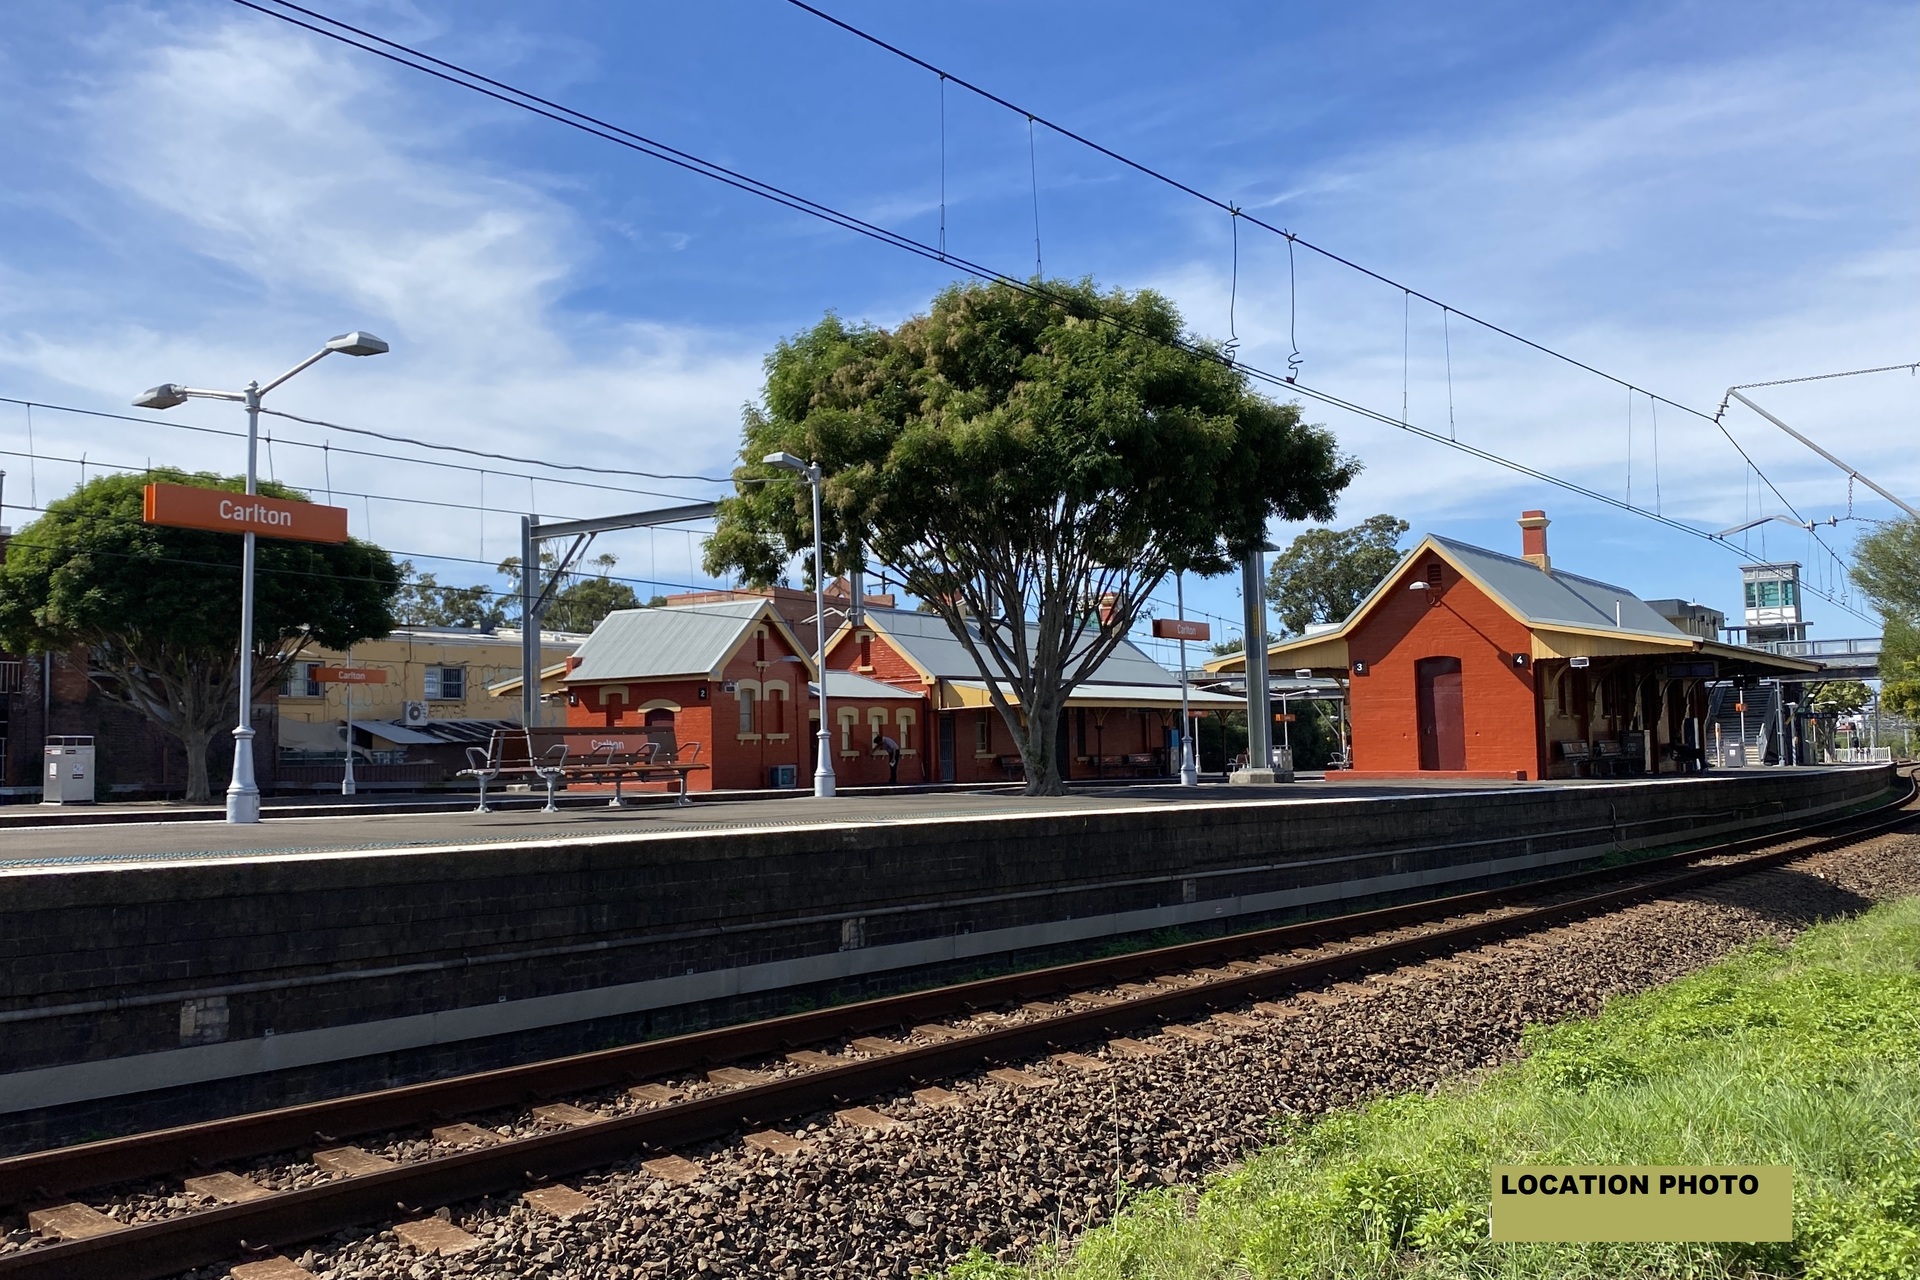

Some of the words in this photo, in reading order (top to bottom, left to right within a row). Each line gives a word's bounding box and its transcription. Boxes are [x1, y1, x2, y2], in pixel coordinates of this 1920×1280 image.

[219, 500, 291, 527] Carlton
[1176, 624, 1197, 636] Carlton
[1516, 655, 1524, 665] 4
[1356, 663, 1363, 672] 3
[338, 671, 366, 680] Carlton
[700, 689, 706, 698] 2
[570, 695, 575, 703] 1
